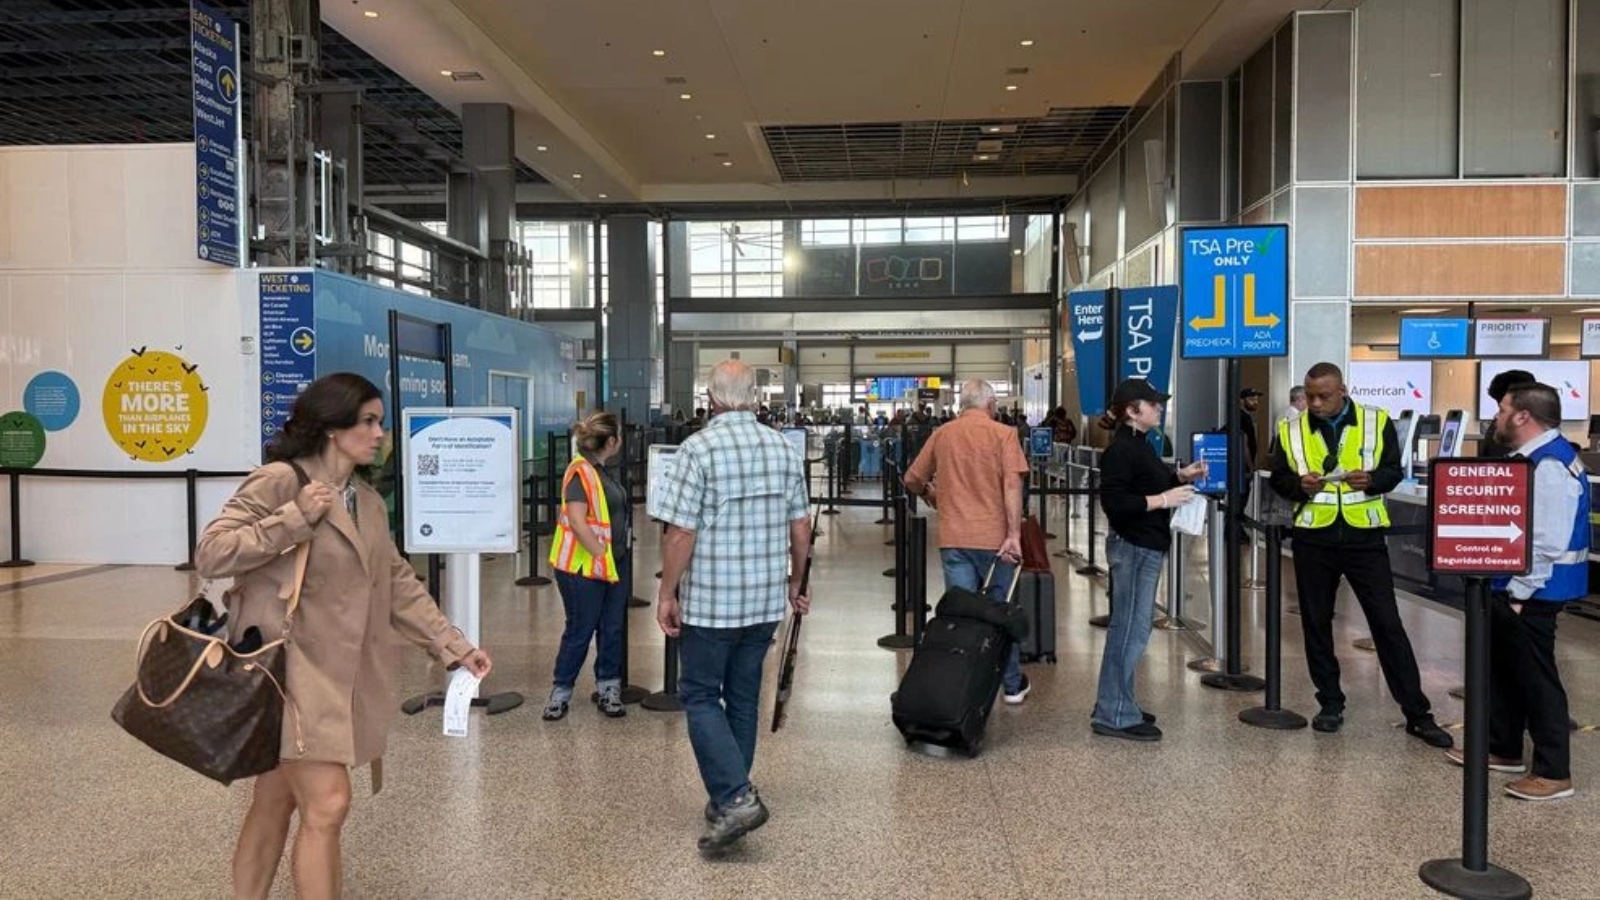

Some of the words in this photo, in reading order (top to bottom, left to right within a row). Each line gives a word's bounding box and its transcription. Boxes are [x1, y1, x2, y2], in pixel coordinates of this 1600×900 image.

[194, 8, 214, 28] EAST
[194, 21, 233, 52] TICKETING
[195, 40, 218, 60] Alaska
[195, 56, 213, 74] Copa
[195, 73, 214, 91] Delta
[196, 91, 233, 117] Southwest
[1189, 239, 1222, 255] TSA
[1226, 237, 1255, 254] Pre
[1214, 255, 1251, 266] ONLY
[261, 275, 288, 284] WEST
[261, 284, 311, 293] TICKETING
[1075, 304, 1104, 315] Enter
[1077, 314, 1104, 325] Here
[1127, 297, 1153, 351] TSA
[1481, 323, 1528, 333] PRIORITY
[1254, 331, 1271, 341] ADA
[364, 334, 391, 359] Mor
[1186, 338, 1232, 349] PRECHECK
[1243, 341, 1281, 352] PRIORITY
[128, 381, 182, 392] THERE'S
[1350, 386, 1406, 396] American
[121, 393, 190, 412] MORE
[119, 414, 142, 422] THAN
[143, 414, 191, 422] AIRPLANES
[122, 423, 136, 434] IN
[140, 423, 163, 434] THE
[166, 423, 191, 434] SKY
[1448, 466, 1513, 477] GENERAL
[1446, 485, 1515, 496] SECURITY
[1438, 504, 1522, 515] SCREENING
[1455, 544, 1490, 552] Control
[1437, 556, 1482, 565] Seguridad
[1484, 557, 1521, 565] General
